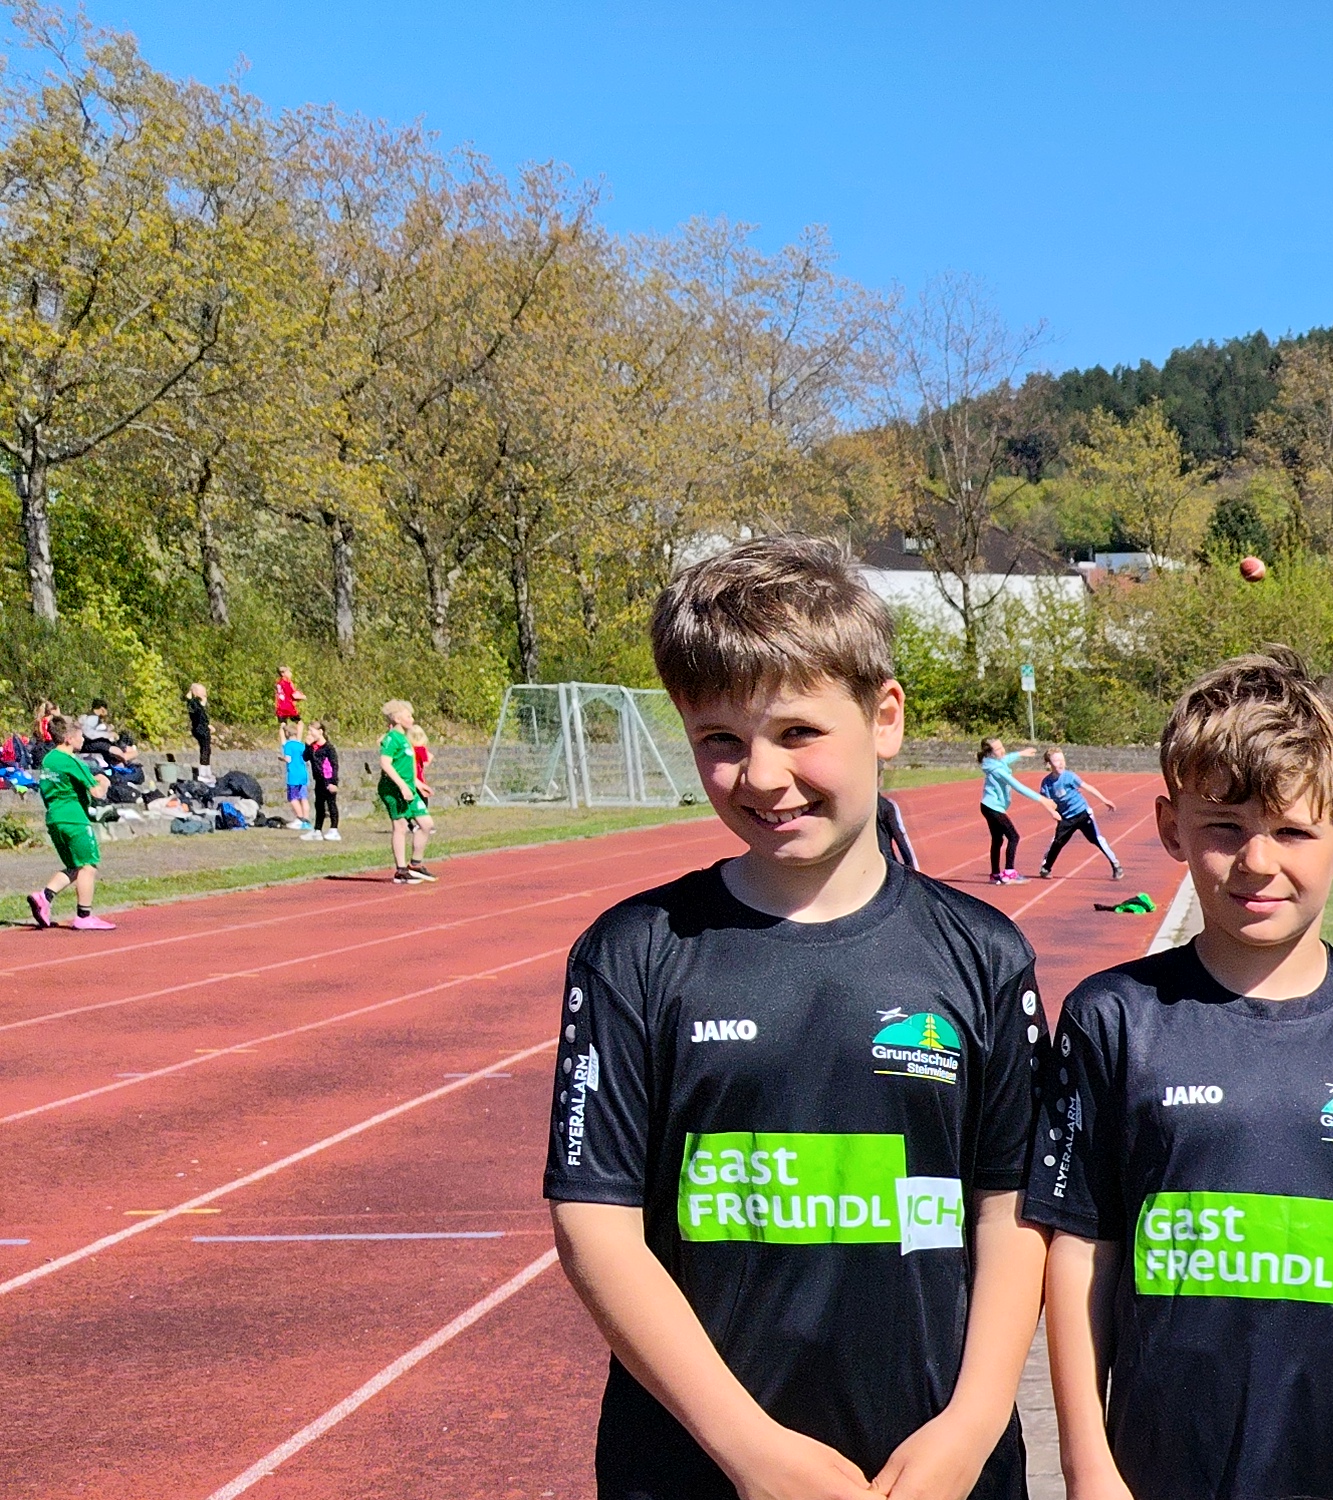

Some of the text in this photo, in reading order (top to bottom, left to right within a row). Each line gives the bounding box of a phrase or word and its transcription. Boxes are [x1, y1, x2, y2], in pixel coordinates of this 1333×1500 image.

[691, 1019, 758, 1042] JAKO
[872, 1045, 958, 1070] Grundschule
[567, 1054, 590, 1166] FLYERALARM
[1162, 1085, 1223, 1107] JAKO
[688, 1146, 798, 1186] Gast
[1053, 1096, 1076, 1198] FLYERALARM
[1143, 1202, 1246, 1243] Gast
